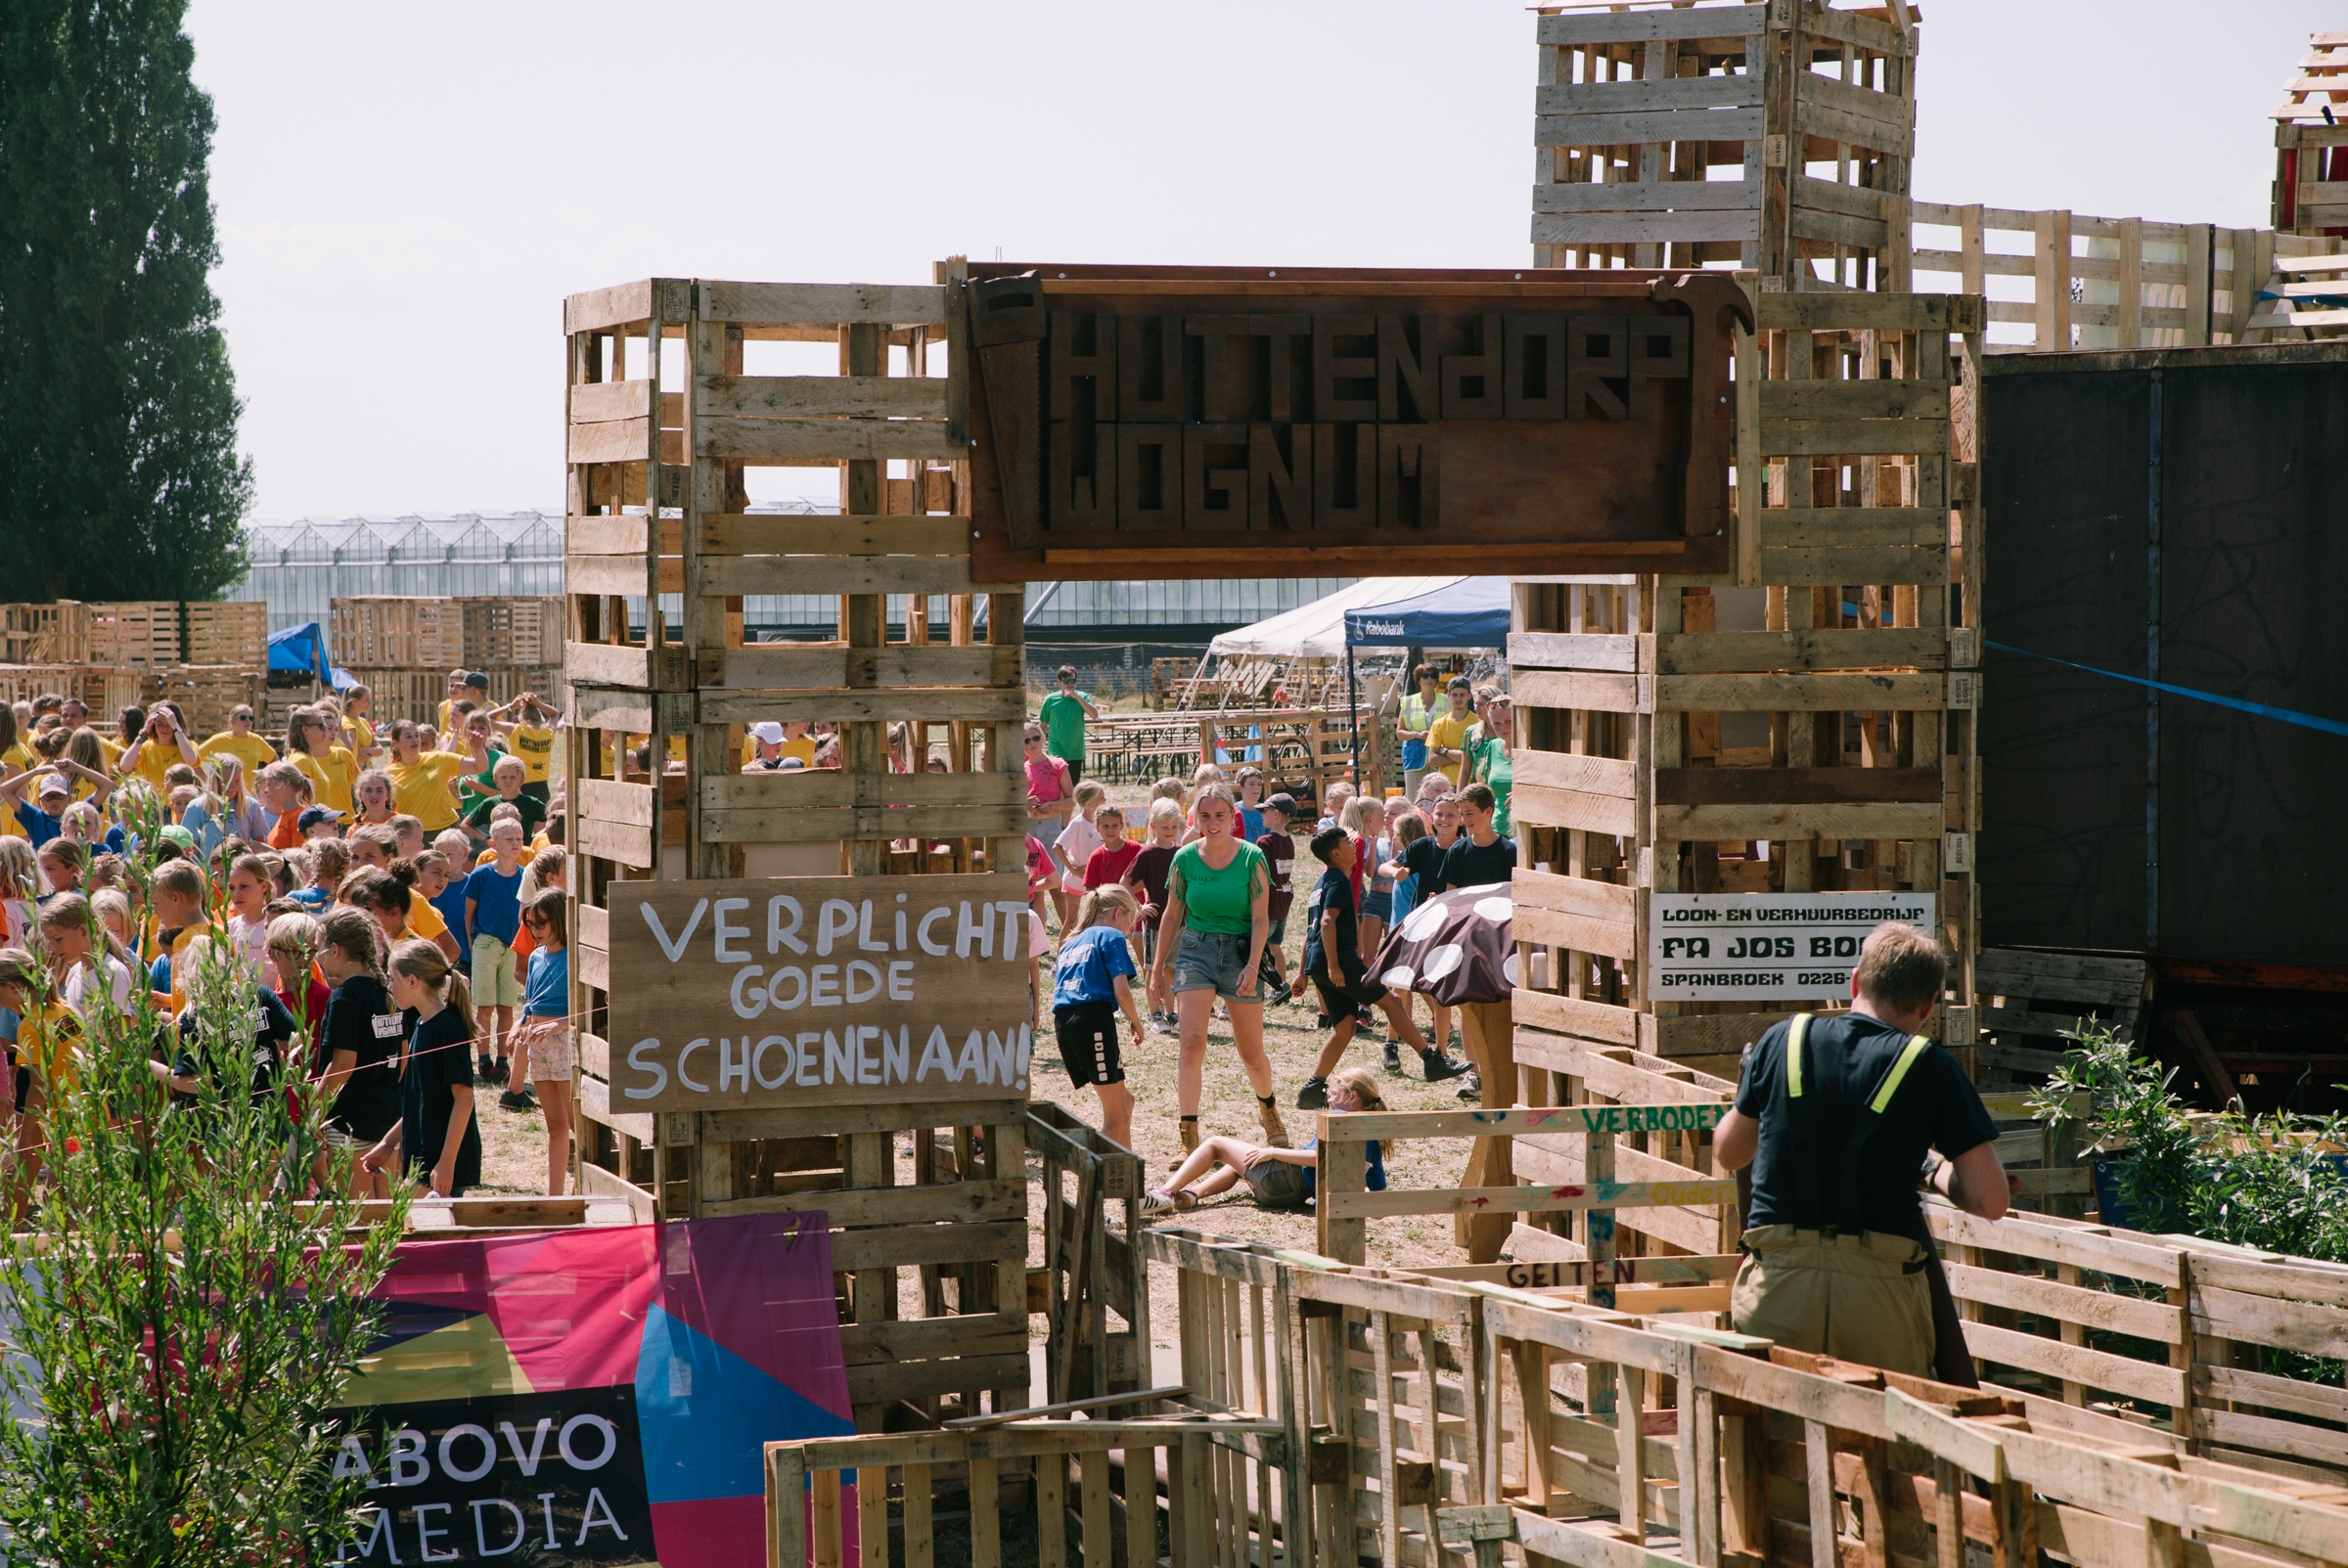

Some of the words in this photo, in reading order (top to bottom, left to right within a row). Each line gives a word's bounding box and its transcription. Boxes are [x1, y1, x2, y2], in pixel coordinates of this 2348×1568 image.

[1050, 422, 1440, 530] WOGNUM
[1366, 620, 1404, 636] Rabobank
[1727, 909, 1752, 921] EN
[1756, 908, 1924, 921] VERHUURBEDRIJF
[1662, 937, 1710, 959] FA
[1728, 937, 1795, 959] JOS
[730, 960, 914, 1019] GOEDE
[1661, 972, 1784, 987] SPANBROEK
[1797, 972, 1851, 985] 0226-
[624, 1024, 910, 1099] SCHOENEN
[1650, 1182, 1738, 1206] Ouders
[1507, 1259, 1635, 1288] GEITEN
[326, 1413, 616, 1494] ABOVO
[338, 1487, 628, 1567] MEDIA
